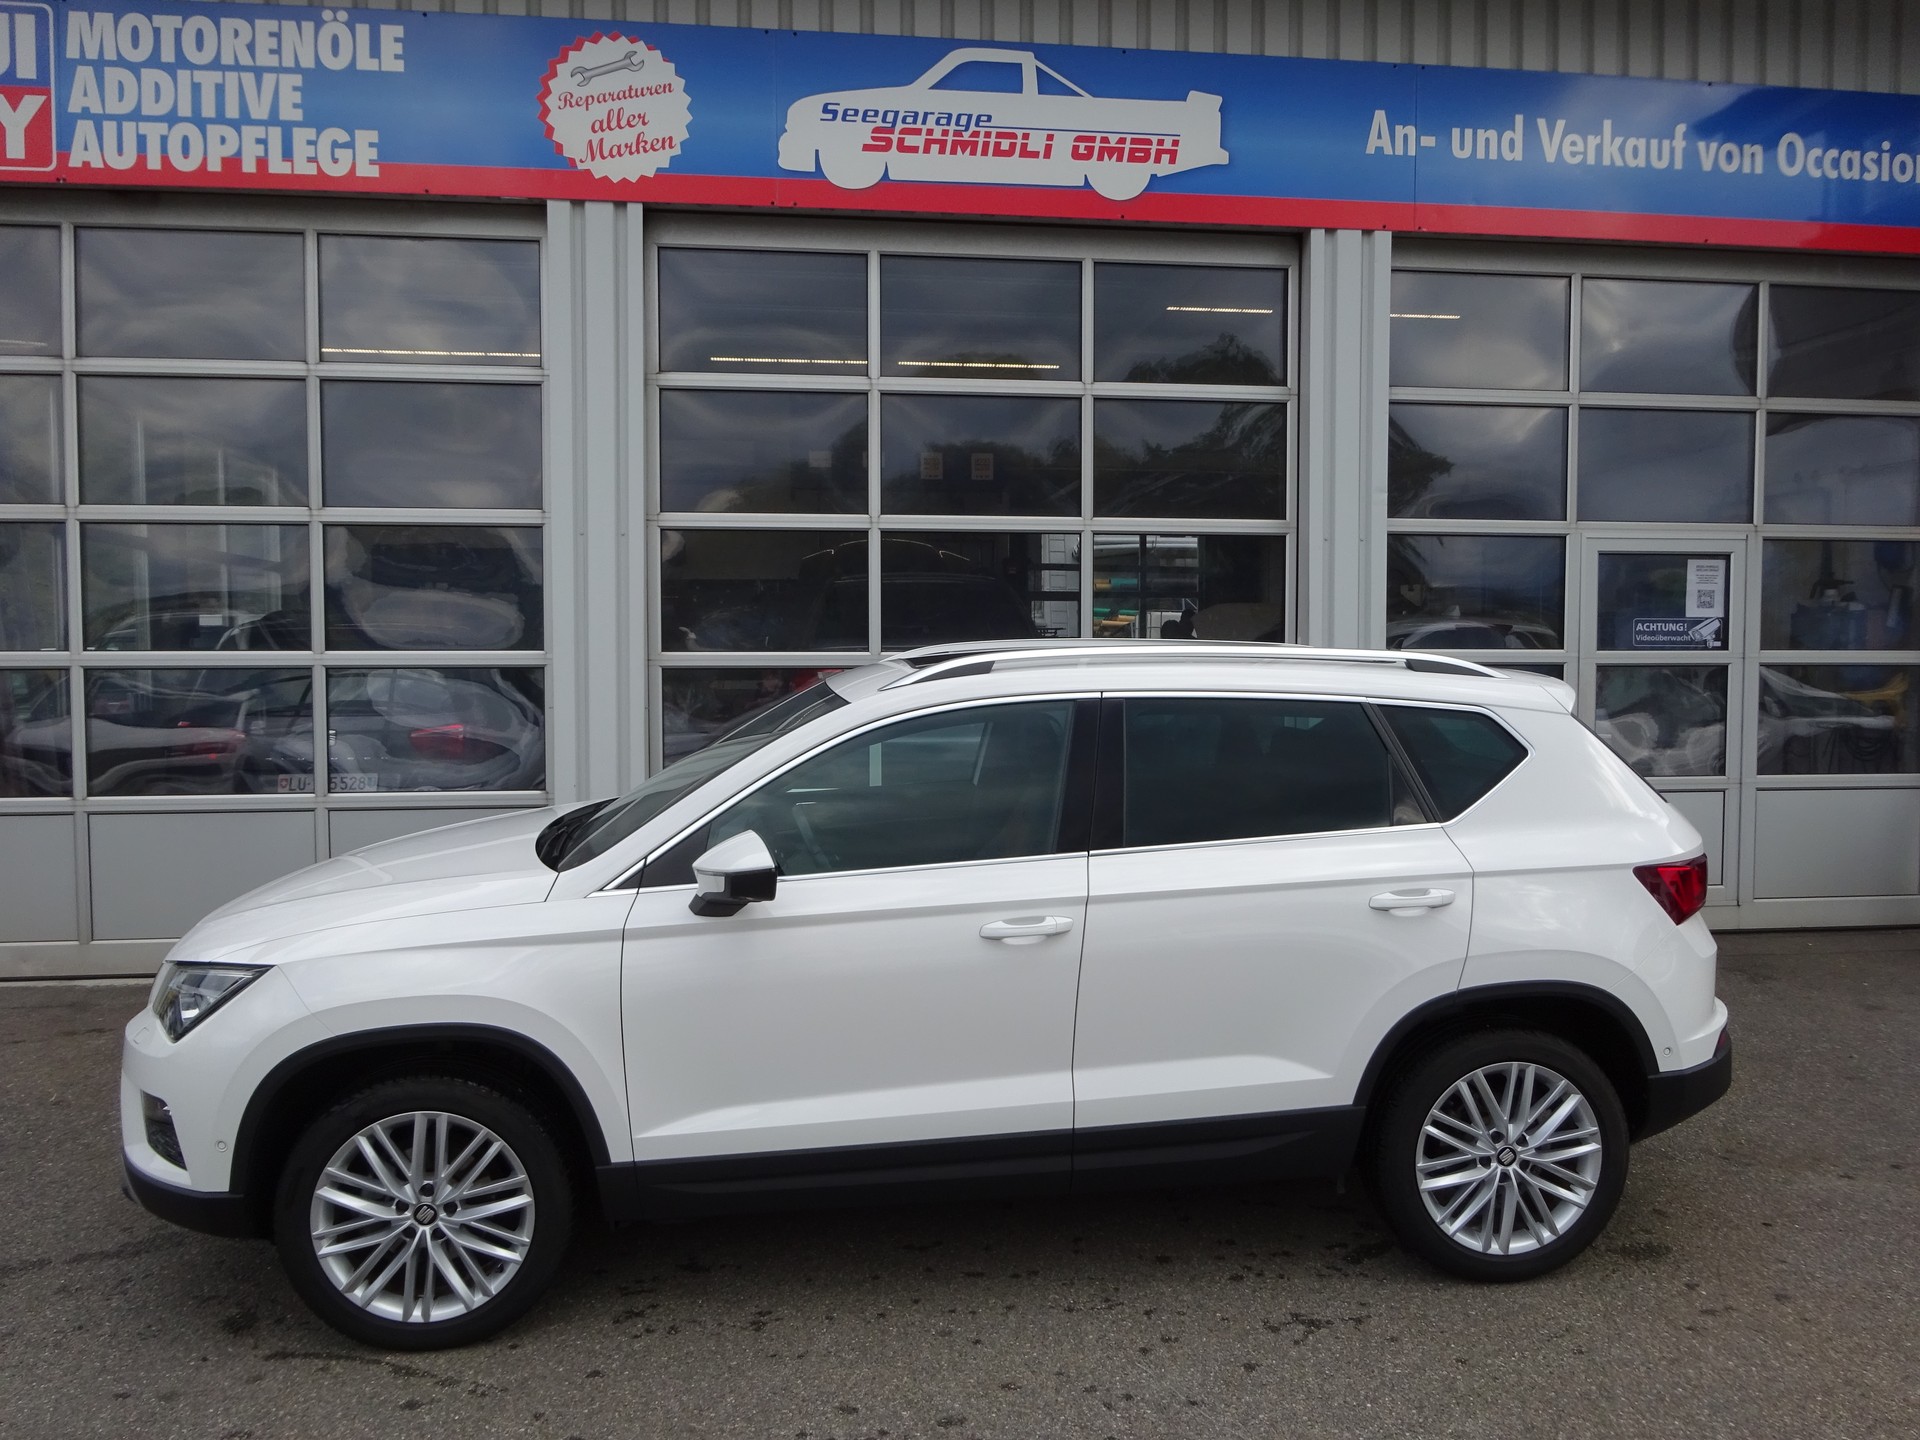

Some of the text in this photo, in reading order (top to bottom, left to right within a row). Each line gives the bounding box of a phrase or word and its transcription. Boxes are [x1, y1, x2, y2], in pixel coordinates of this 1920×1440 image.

[0, 13, 37, 79] I
[66, 9, 404, 72] MOTORENÖLE
[67, 65, 303, 121] ADDITIVE
[558, 82, 674, 111] Reparaturen
[591, 107, 649, 133] aller
[820, 102, 992, 132] Seegarage
[68, 119, 380, 177] AUTOPFLEGE
[579, 131, 676, 163] Marken
[862, 126, 1180, 165] SCHMIDLI GMBH
[1365, 110, 1920, 183] An- und Verkauf von Occasio
[1636, 622, 1687, 631] ACHTUNG!
